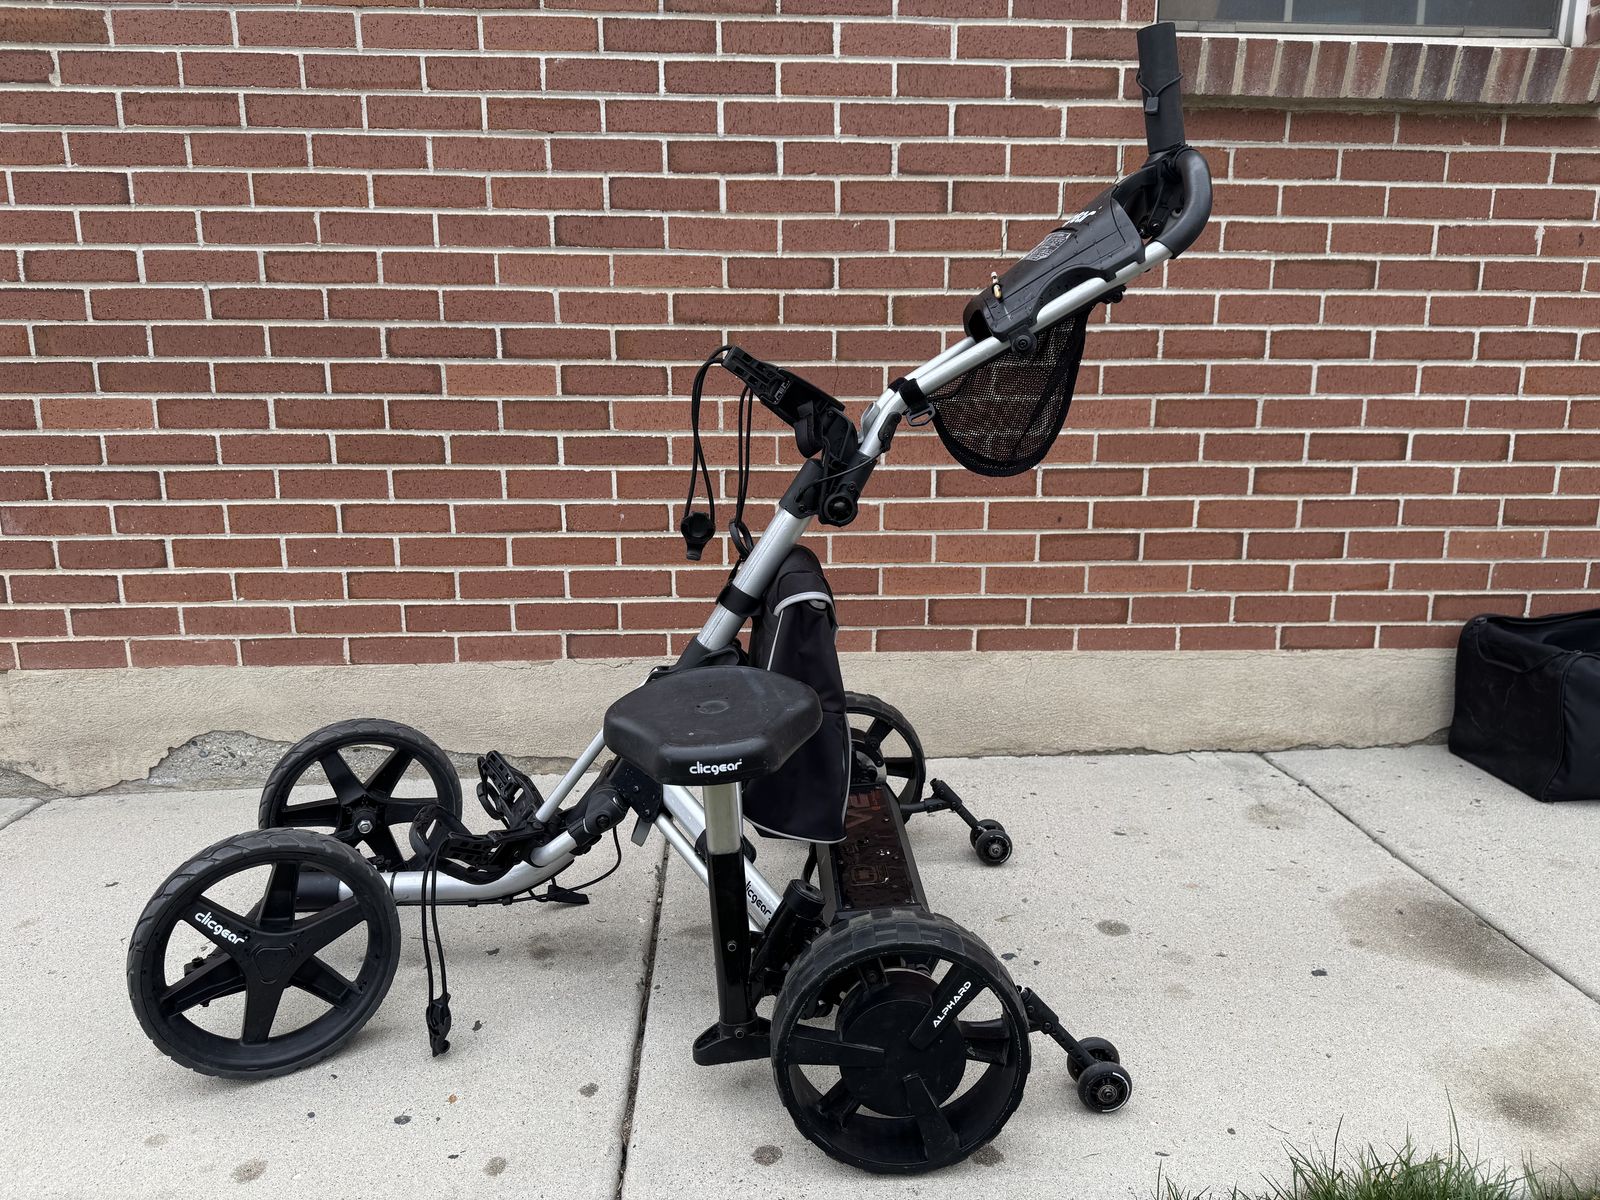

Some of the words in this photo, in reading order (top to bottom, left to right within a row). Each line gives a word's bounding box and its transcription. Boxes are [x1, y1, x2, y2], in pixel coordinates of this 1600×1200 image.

[688, 759, 743, 775] clicgear
[745, 880, 772, 916] licgear
[194, 911, 246, 945] clicgear
[932, 981, 972, 1028] ALPHARD
